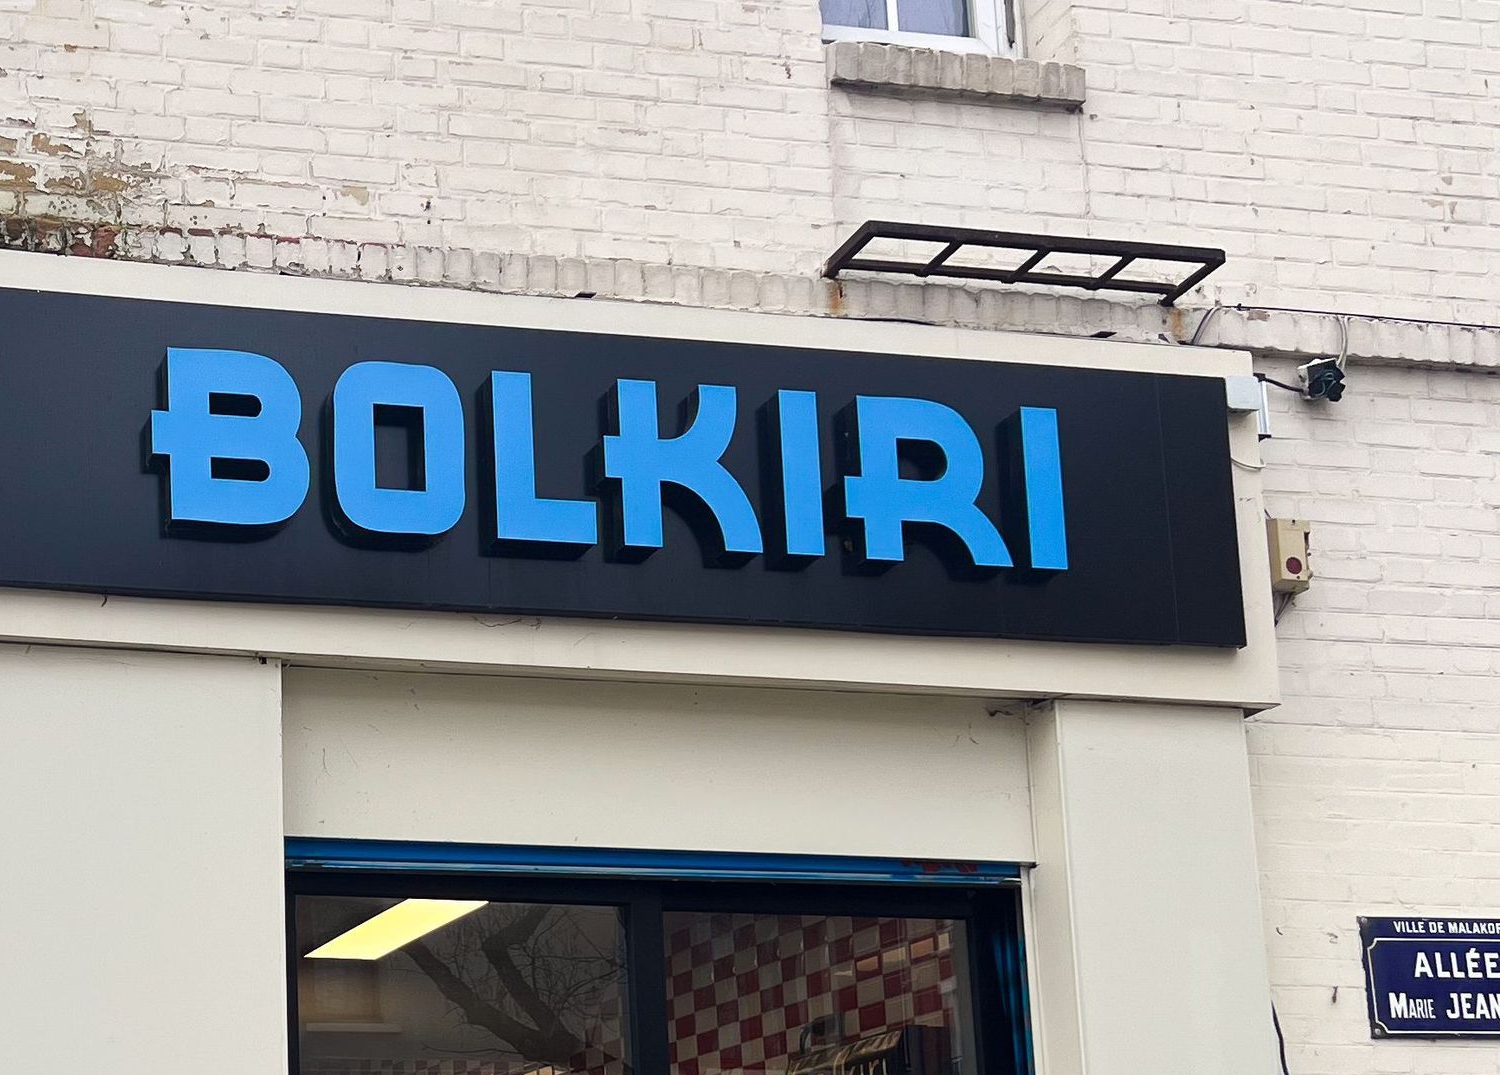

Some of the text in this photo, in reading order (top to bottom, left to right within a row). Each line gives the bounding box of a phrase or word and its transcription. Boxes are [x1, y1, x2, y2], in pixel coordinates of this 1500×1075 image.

[147, 345, 1072, 572] BOLKIRI
[1393, 921, 1426, 933] VILLE
[1429, 921, 1445, 933] DE
[1414, 947, 1500, 979] ALLÉE
